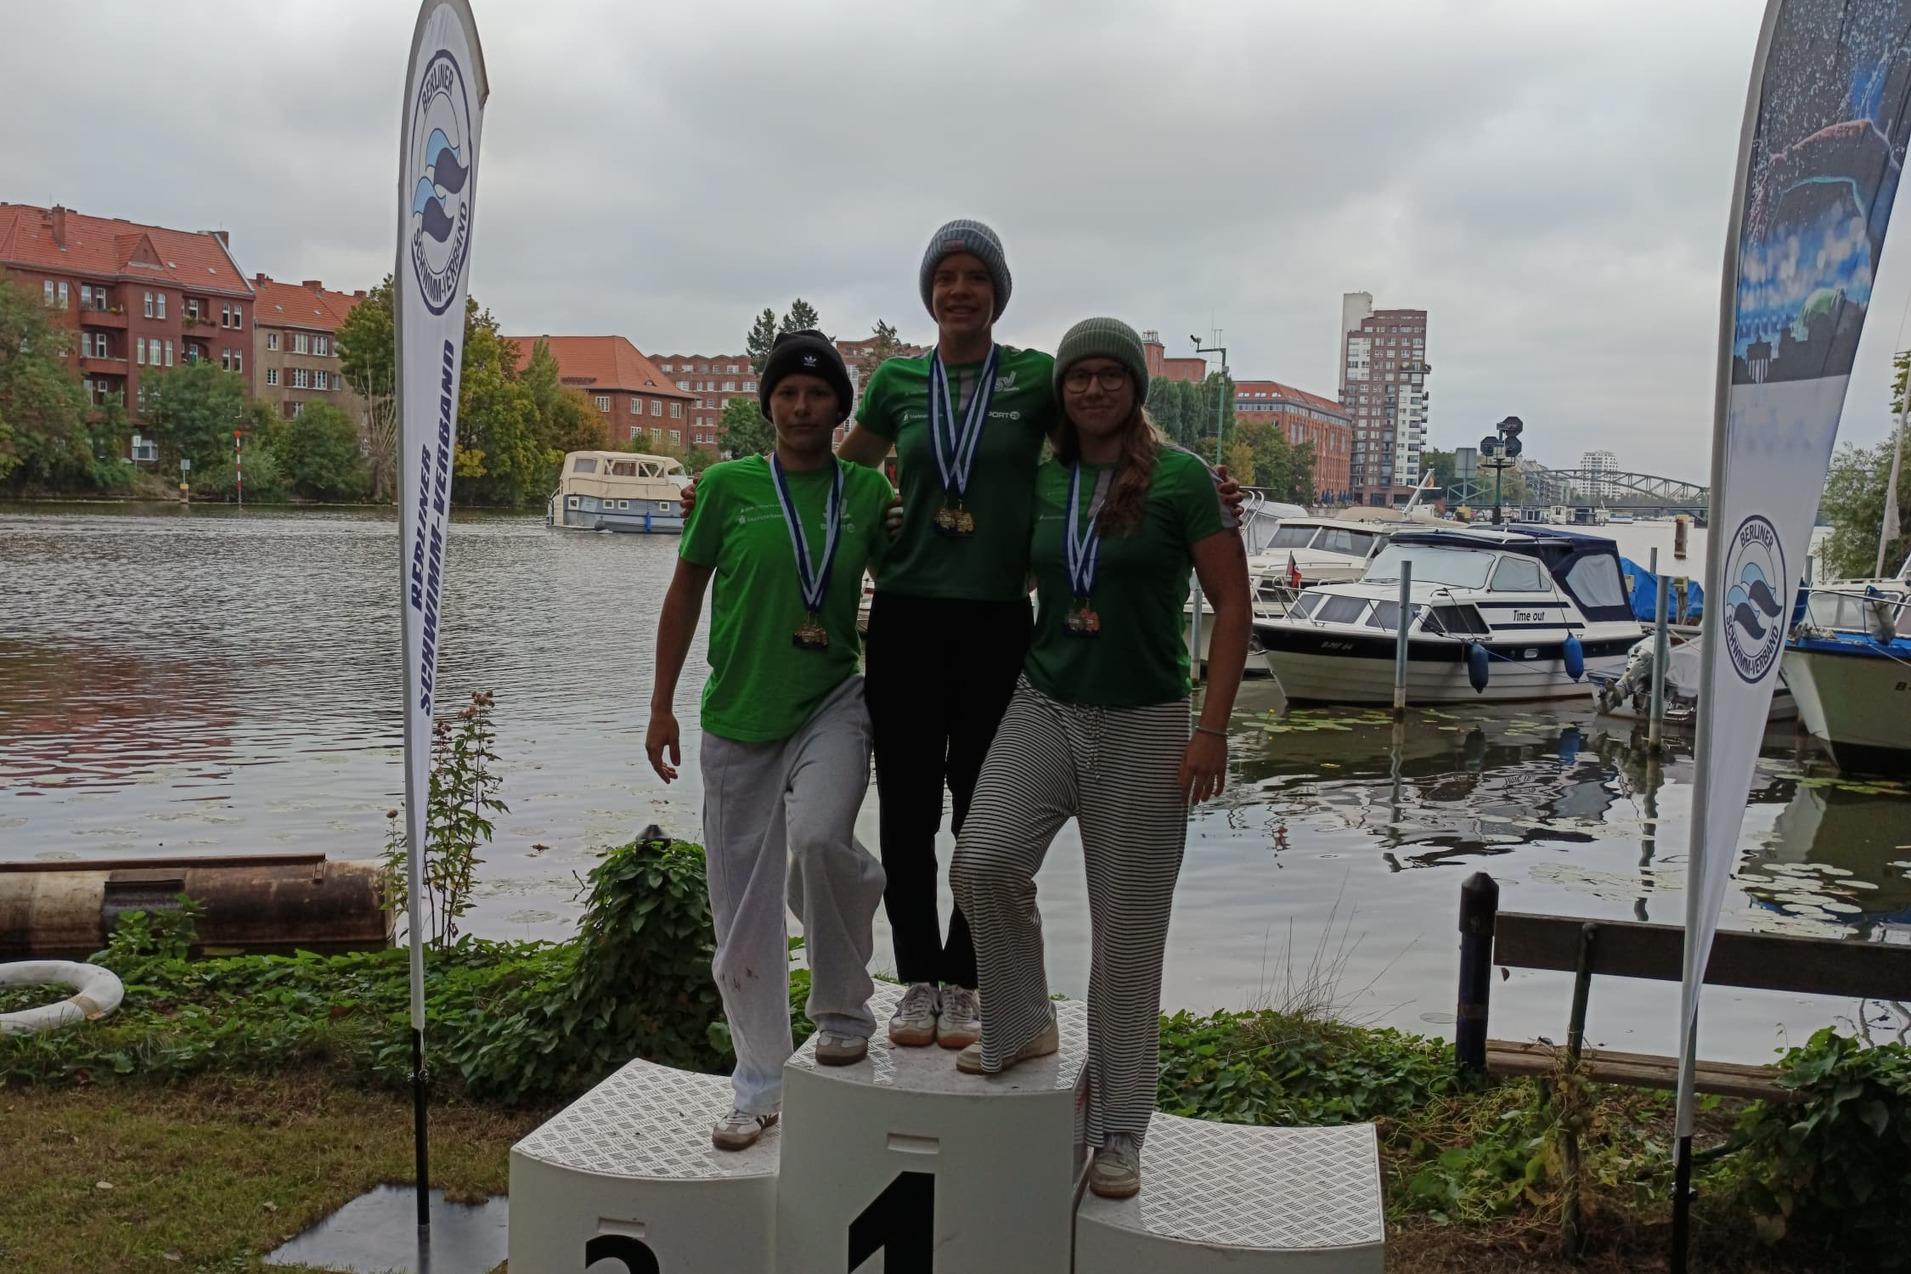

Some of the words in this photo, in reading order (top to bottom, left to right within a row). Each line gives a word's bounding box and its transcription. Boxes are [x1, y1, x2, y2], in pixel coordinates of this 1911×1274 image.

[422, 64, 453, 115] BERLINER
[411, 444, 431, 613] BERLINER
[420, 338, 455, 717] SCHWIMM-VERBAND
[1740, 524, 1774, 552] BERLINER
[1513, 610, 1531, 621] Time
[1532, 611, 1545, 621] out
[1726, 614, 1779, 675] SCHWIMM-VERBAND
[848, 1171, 935, 1274] 1
